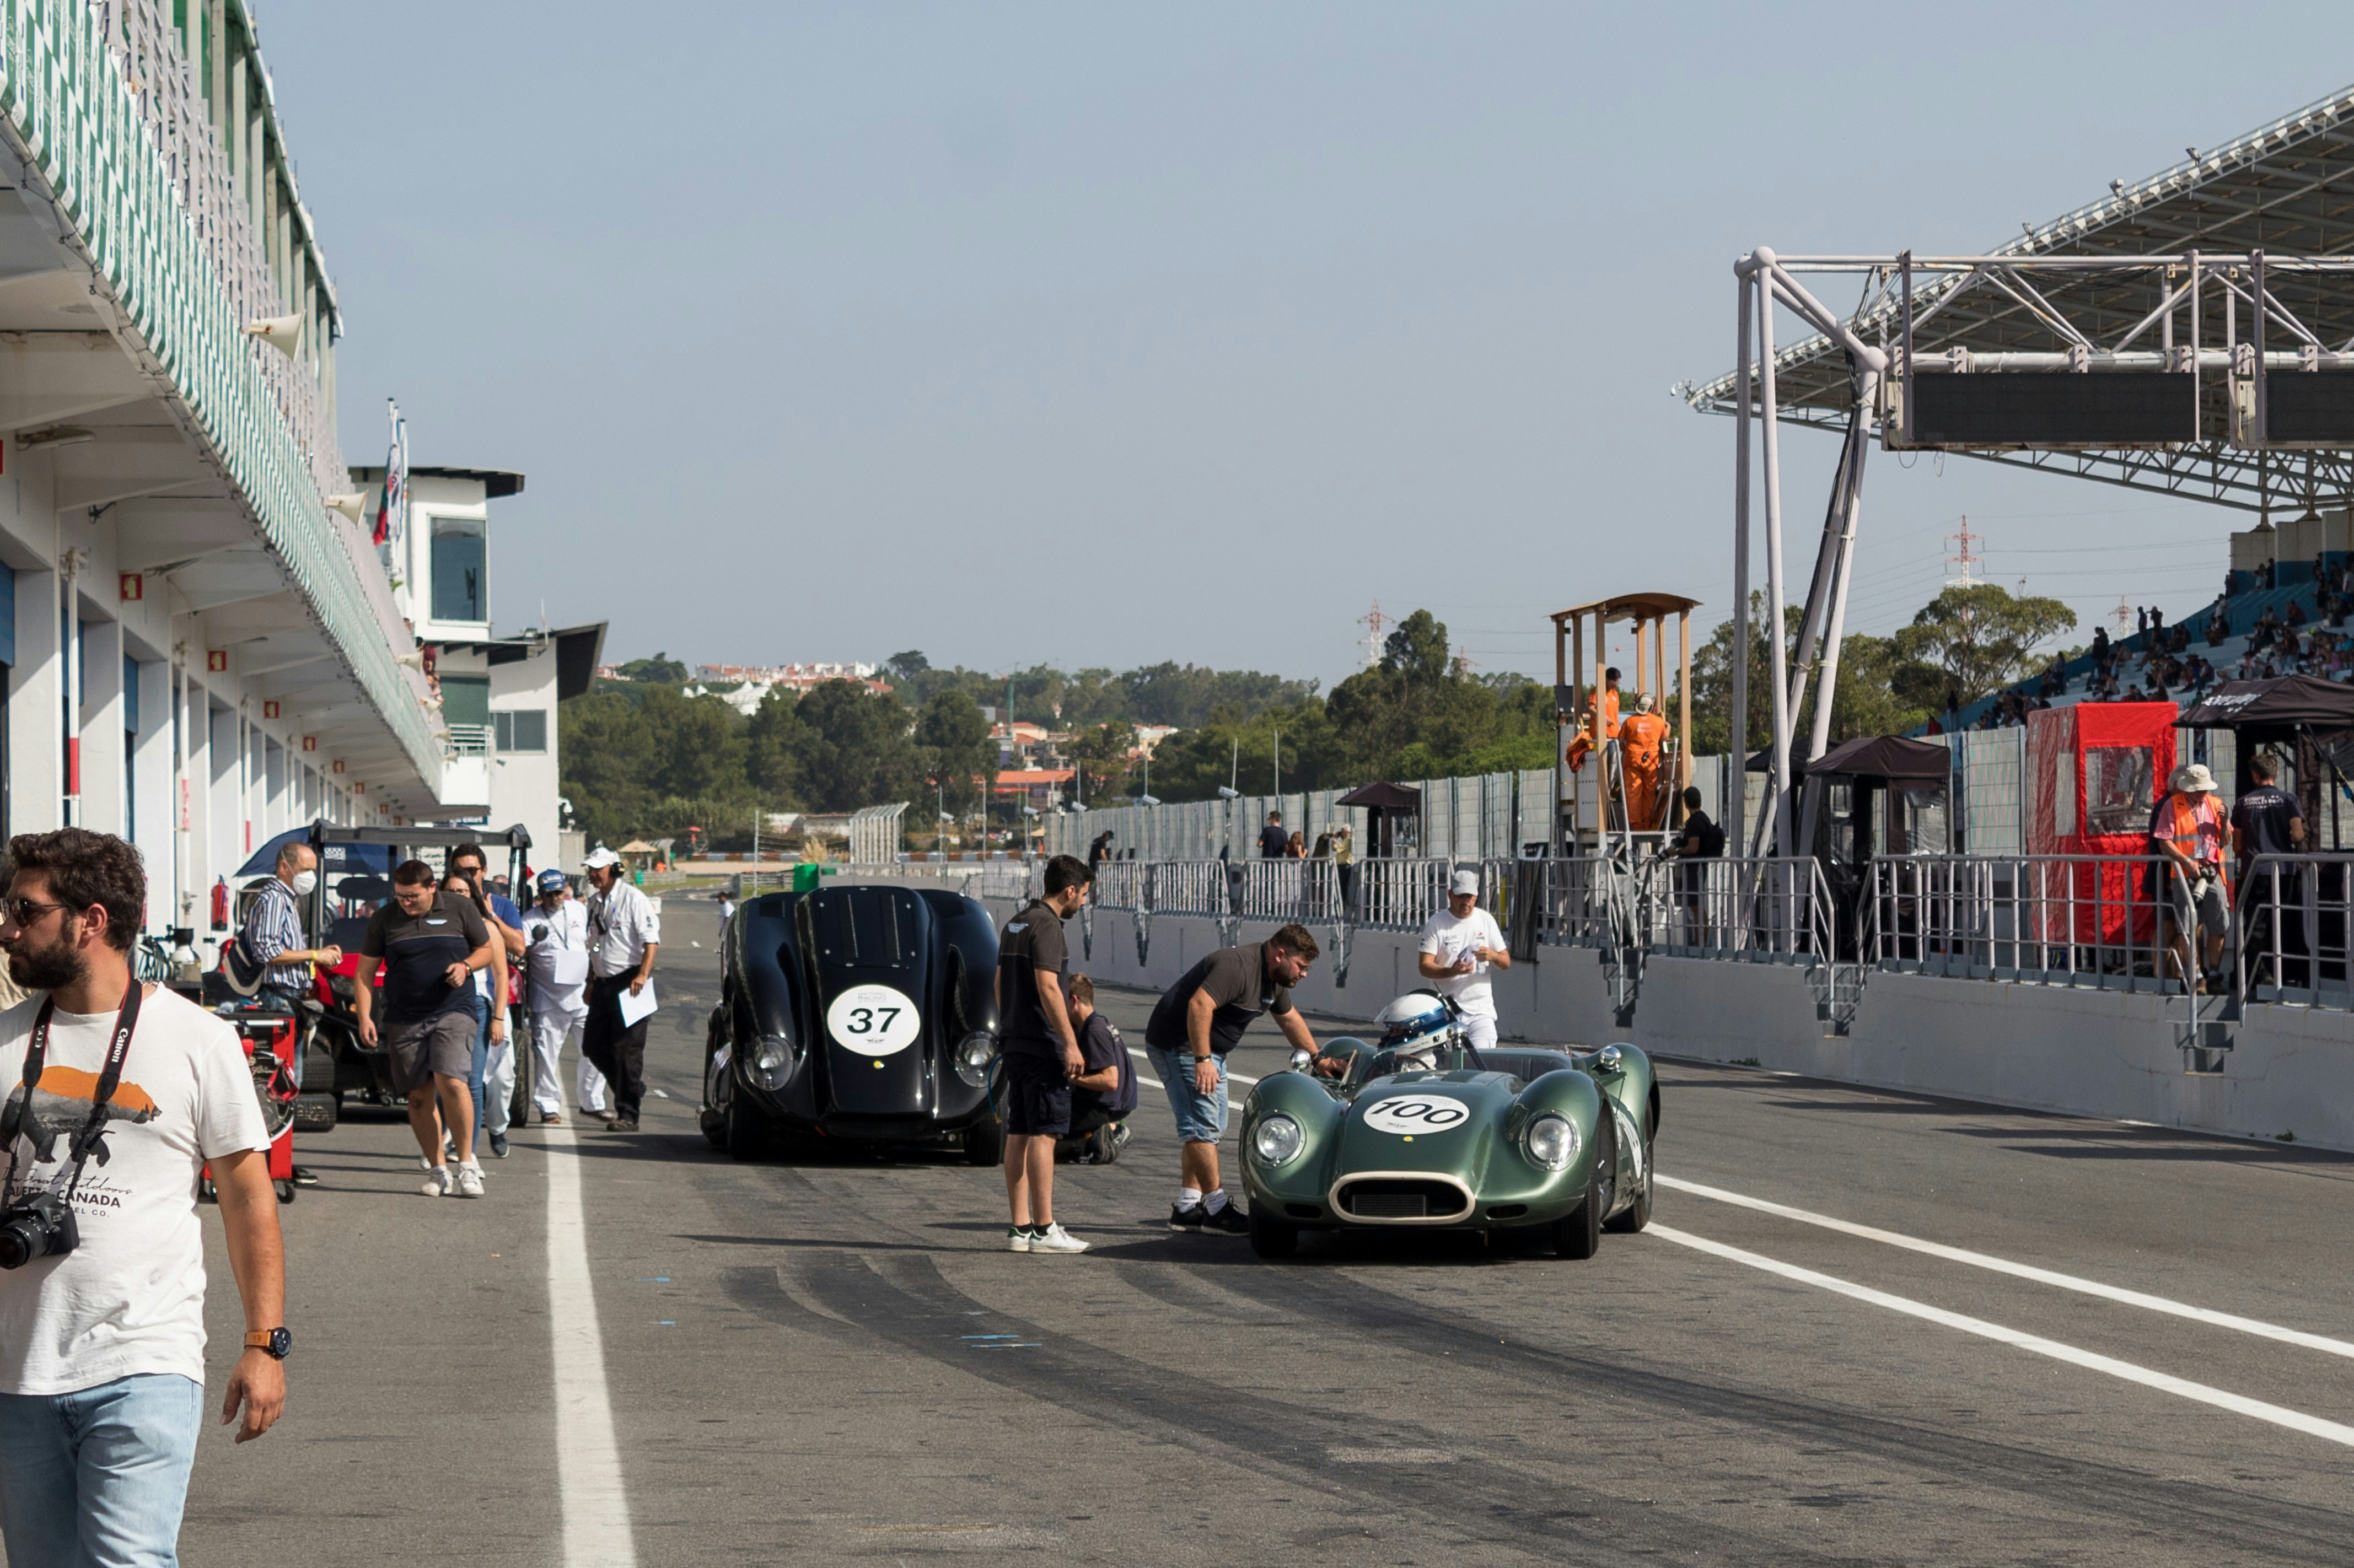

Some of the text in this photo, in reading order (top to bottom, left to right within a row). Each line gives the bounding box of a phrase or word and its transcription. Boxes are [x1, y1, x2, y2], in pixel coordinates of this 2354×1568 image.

[847, 1008, 901, 1034] 37
[111, 1028, 128, 1063] Canon
[1371, 1101, 1464, 1124] 100
[56, 1189, 121, 1208] CANADA
